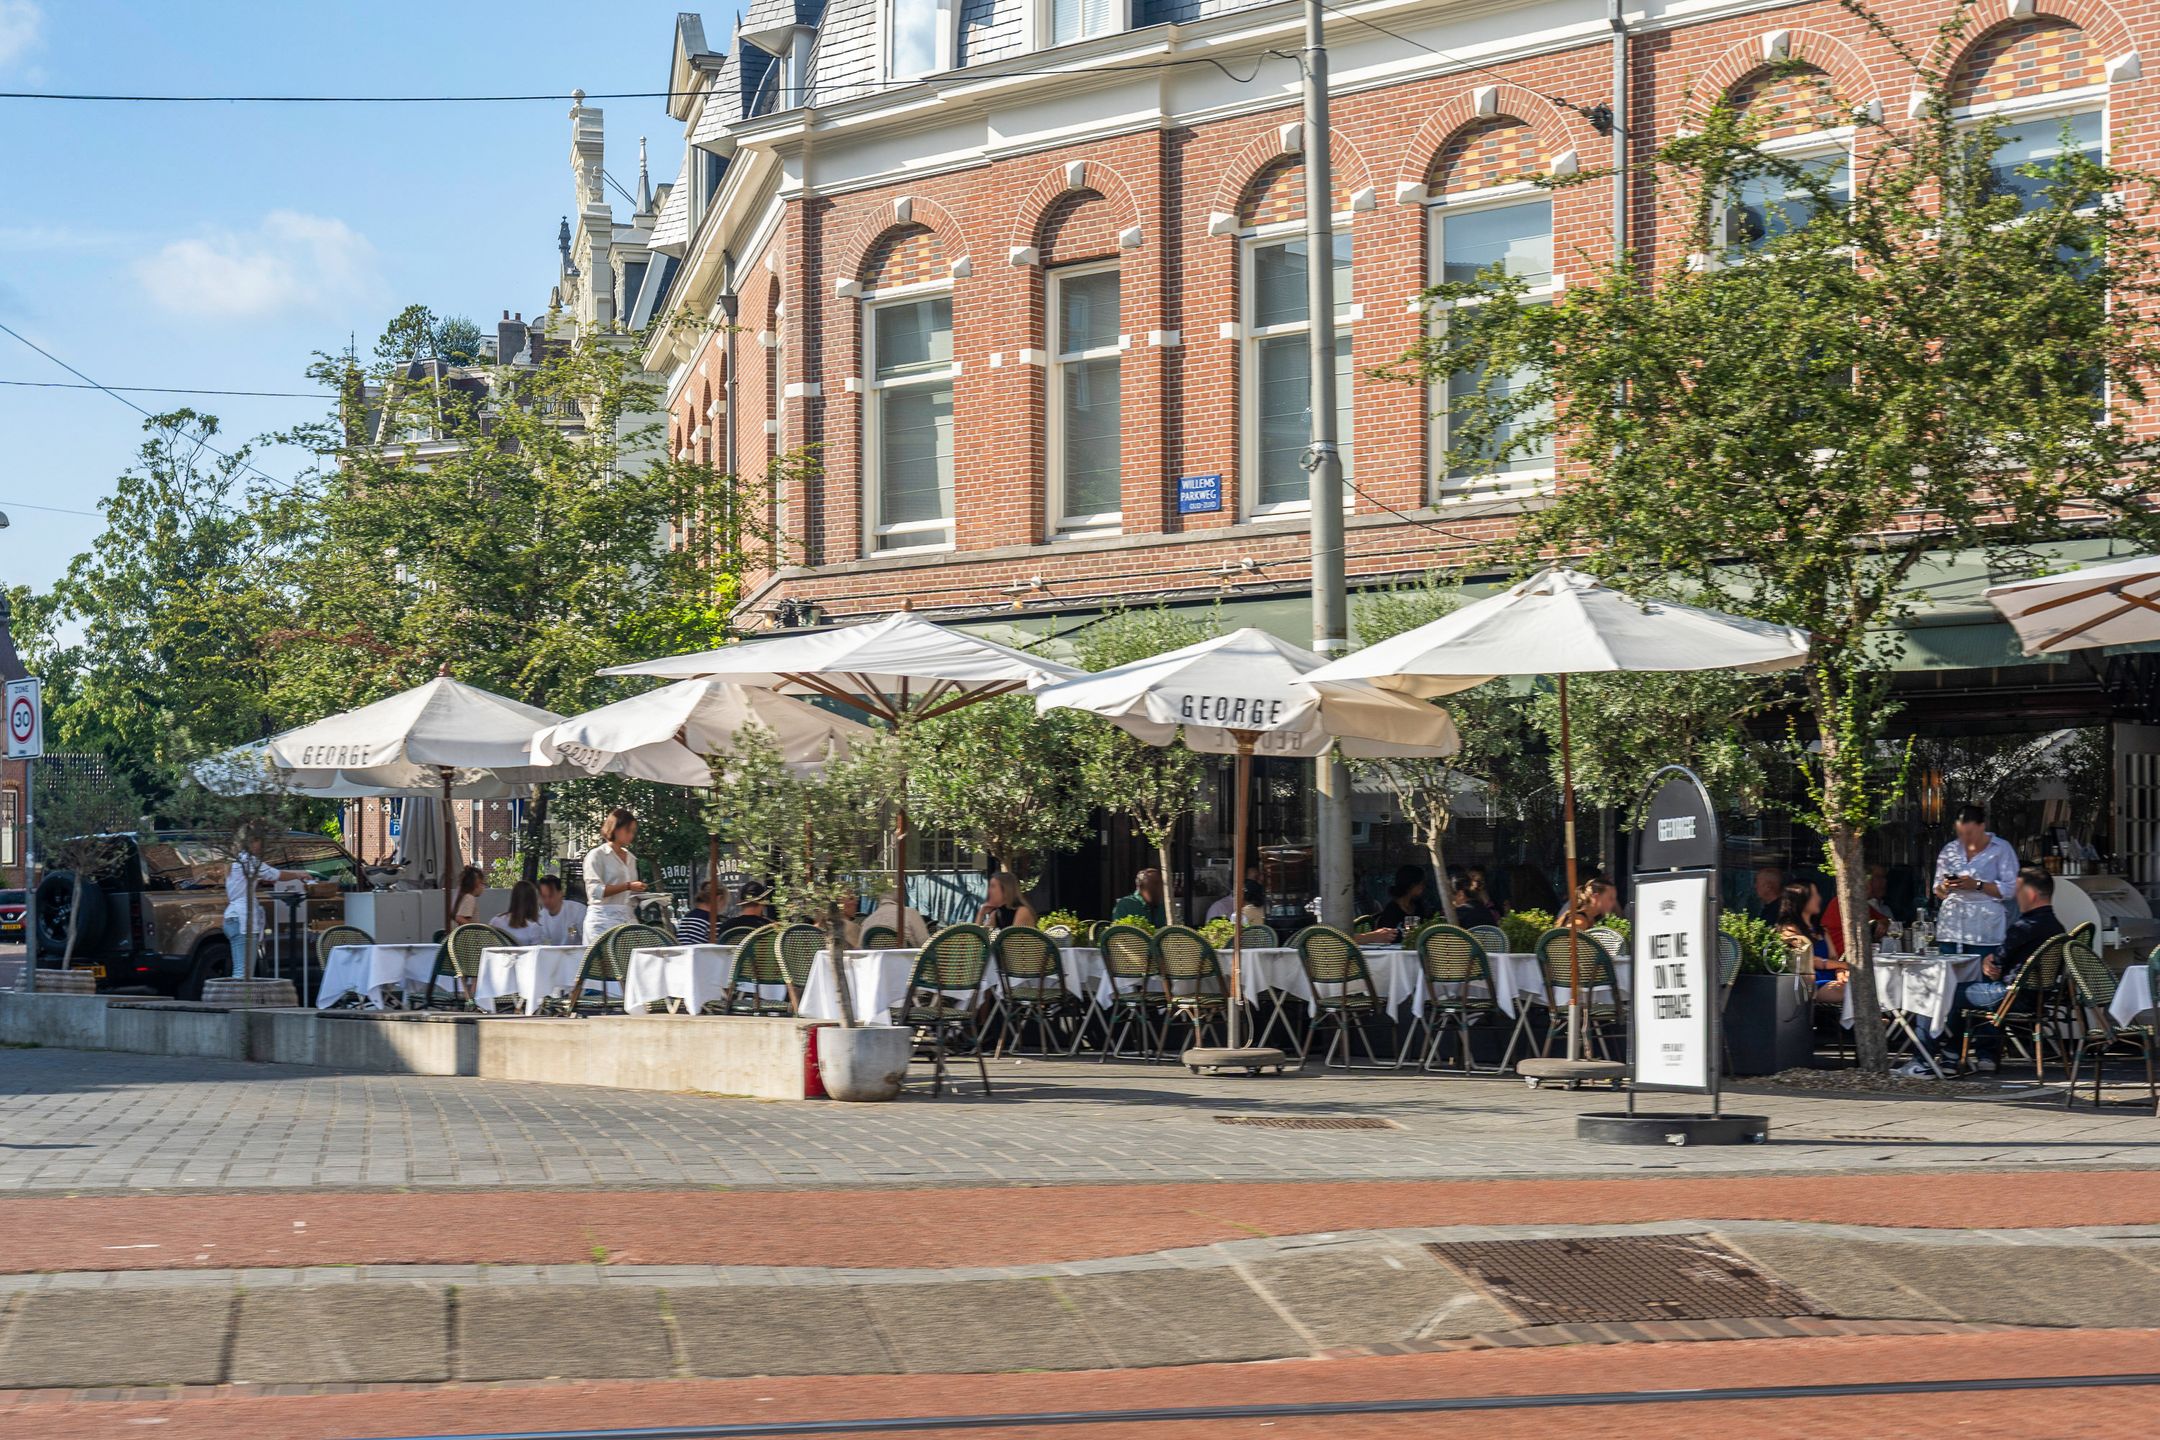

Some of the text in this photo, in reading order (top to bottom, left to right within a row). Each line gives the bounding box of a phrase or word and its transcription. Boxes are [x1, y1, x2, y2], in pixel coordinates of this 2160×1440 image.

[1181, 478, 1216, 489] WILLEMS
[1180, 490, 1217, 501] PARKWEG
[14, 685, 30, 694] ZONE
[1182, 695, 1282, 724] GEORGE
[14, 711, 30, 728] 30
[303, 744, 371, 765] GEORGE
[393, 825, 400, 834] P
